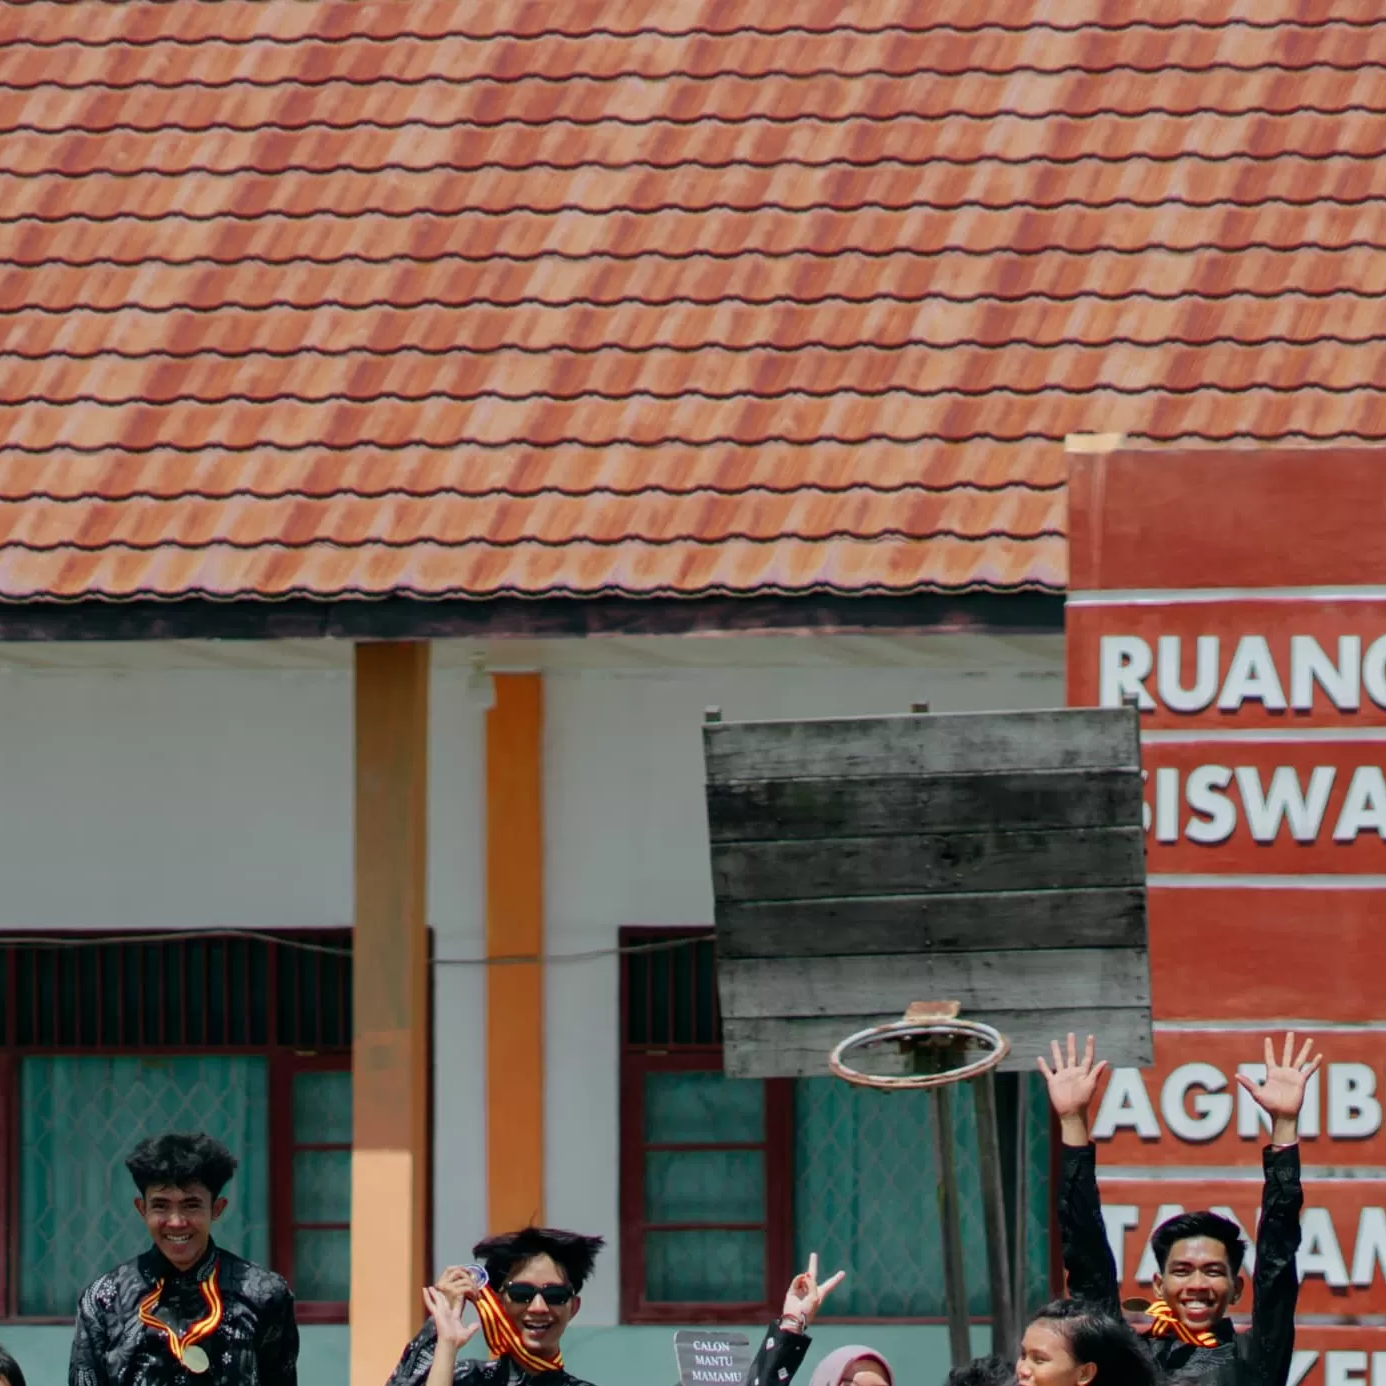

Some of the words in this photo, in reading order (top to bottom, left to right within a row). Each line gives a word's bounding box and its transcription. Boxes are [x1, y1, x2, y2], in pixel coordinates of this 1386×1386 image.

[693, 1340, 730, 1352] CALON
[694, 1354, 733, 1367] MANTU
[692, 1369, 742, 1383] MAMAMU
